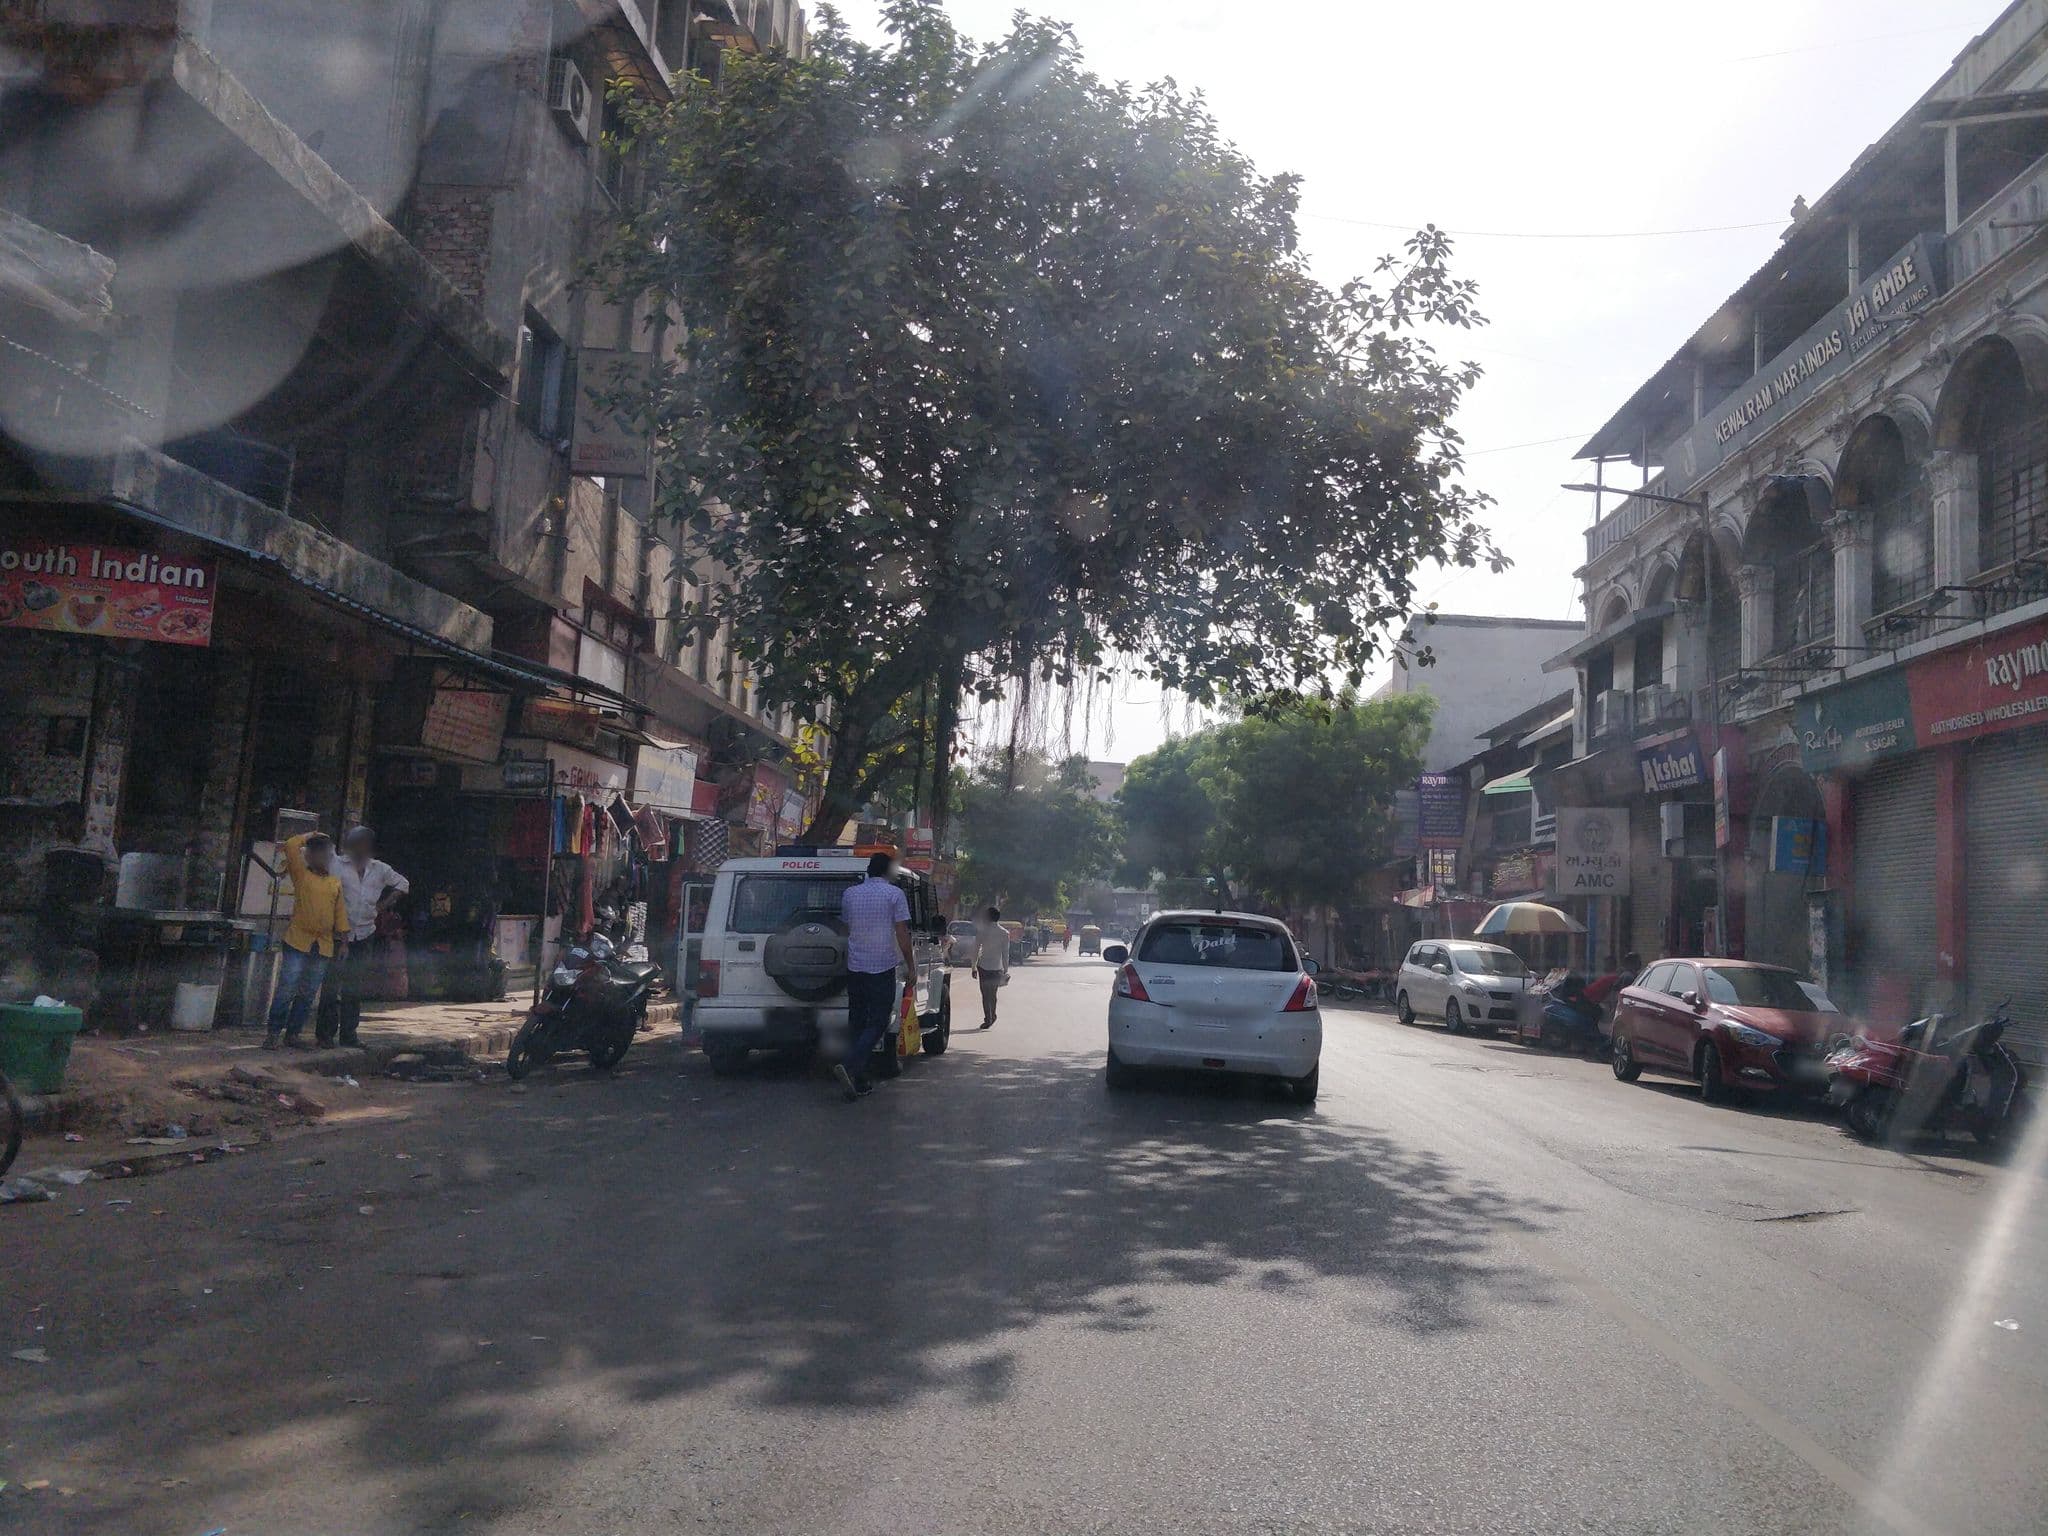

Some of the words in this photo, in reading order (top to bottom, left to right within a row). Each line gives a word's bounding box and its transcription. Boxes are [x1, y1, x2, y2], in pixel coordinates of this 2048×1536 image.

[1872, 255, 1916, 311] AMBE
[1774, 329, 1842, 399] NARAINDAS
[91, 549, 205, 588] Indian
[1930, 711, 1984, 736] AUTHORISED
[1658, 775, 1699, 791] ENTERPRISE
[782, 861, 820, 869] POLICE
[1575, 873, 1614, 888] AMC
